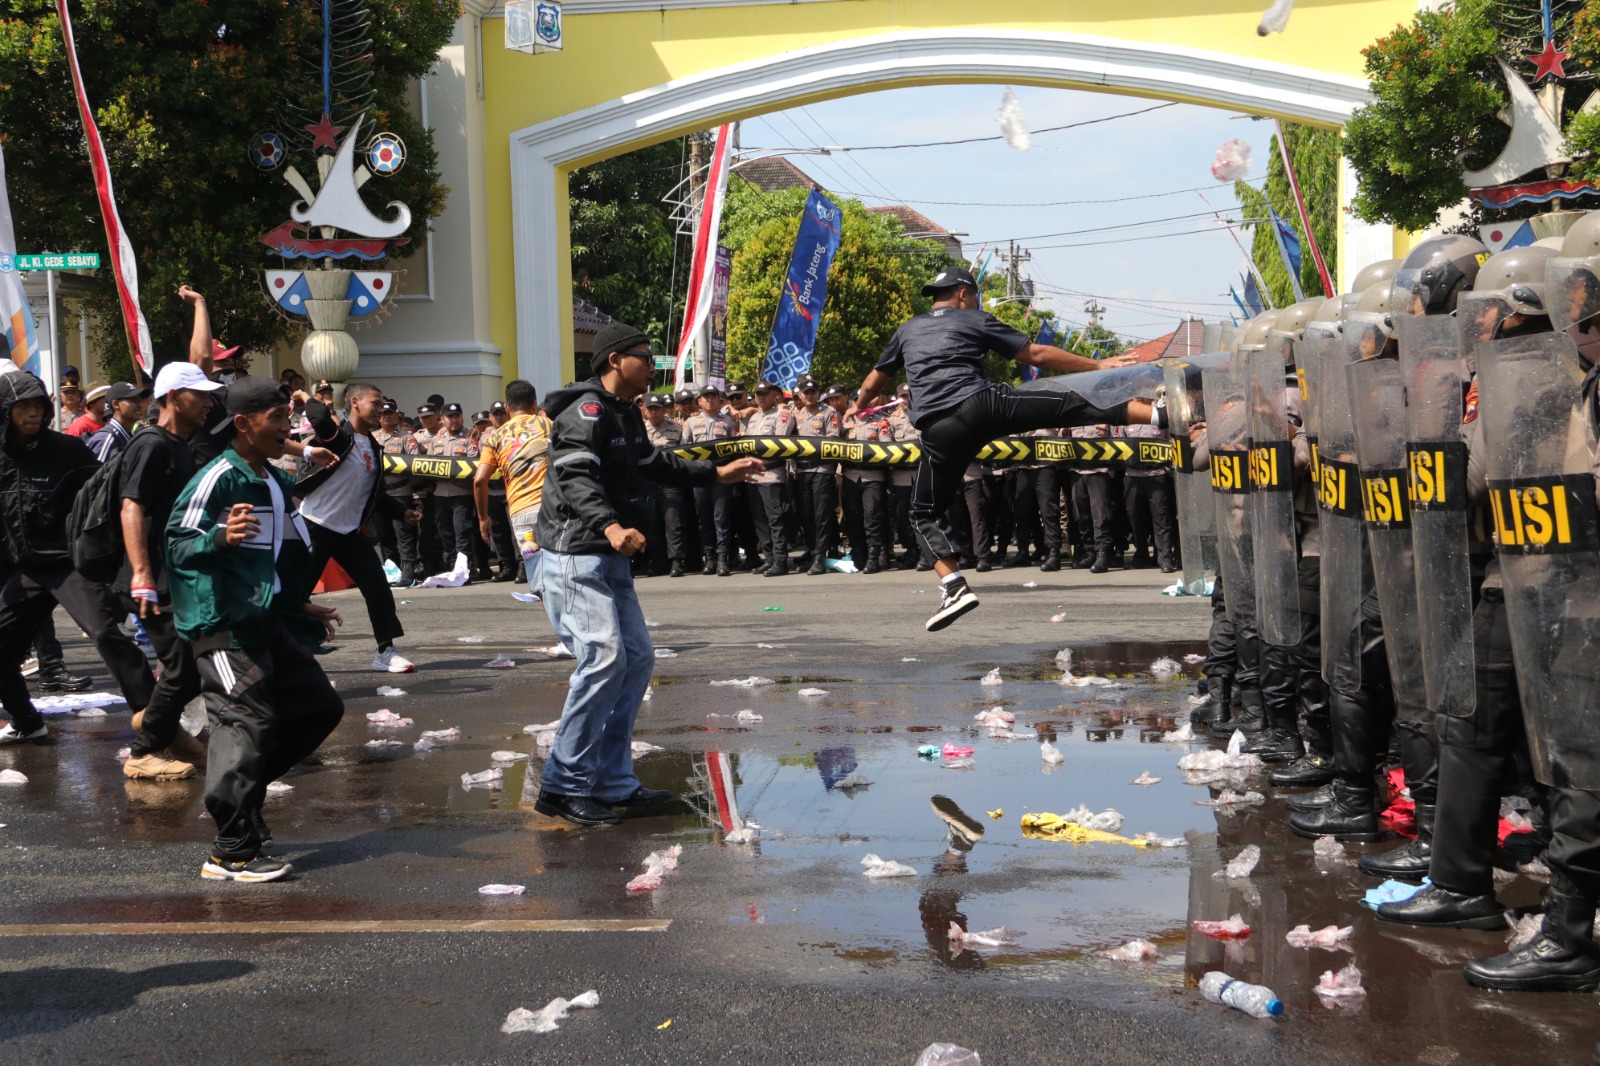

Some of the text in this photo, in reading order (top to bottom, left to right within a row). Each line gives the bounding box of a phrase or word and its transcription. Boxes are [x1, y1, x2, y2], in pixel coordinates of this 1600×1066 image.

[20, 255, 97, 268] JL. KI. GEDE SEBAYU
[799, 242, 826, 305] Bank Jateng
[718, 442, 754, 455] POLISI
[823, 443, 861, 460] POLISI
[1038, 443, 1073, 459] POLISI
[1143, 447, 1173, 462] POLIS
[414, 461, 449, 476] POLISI
